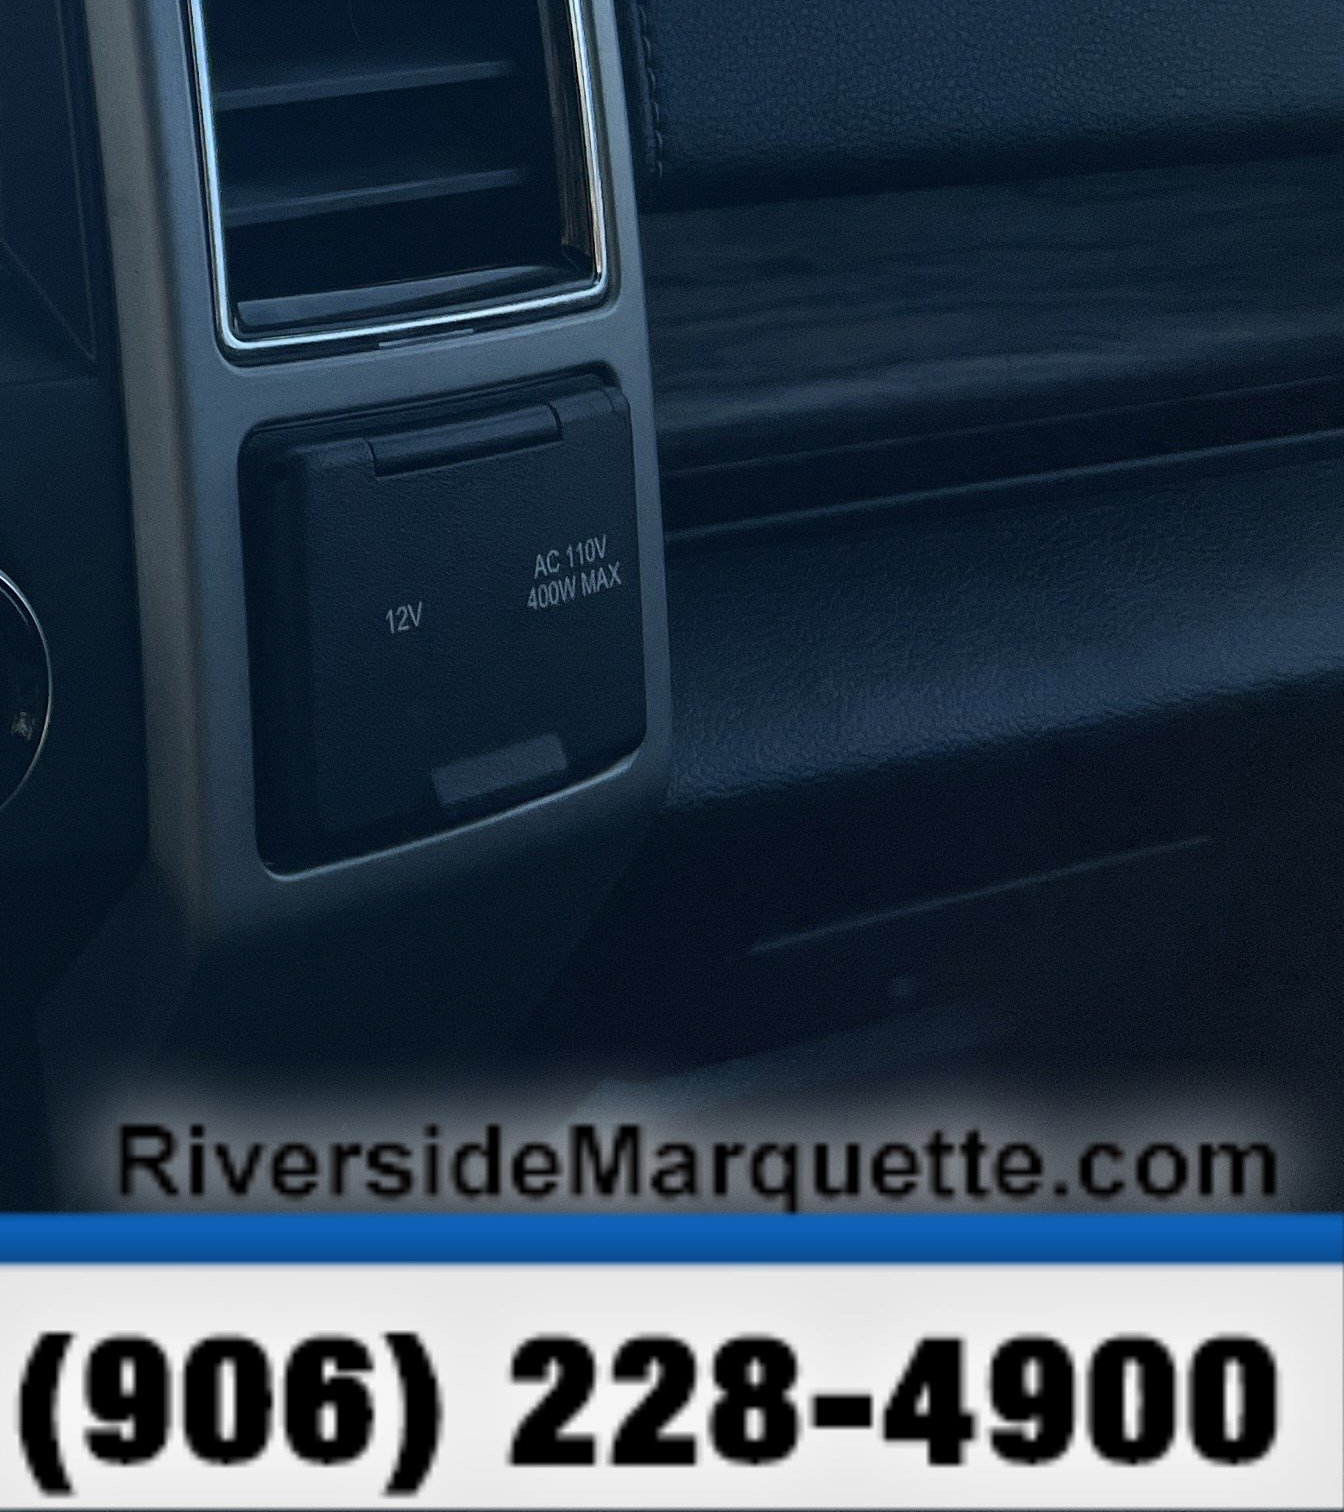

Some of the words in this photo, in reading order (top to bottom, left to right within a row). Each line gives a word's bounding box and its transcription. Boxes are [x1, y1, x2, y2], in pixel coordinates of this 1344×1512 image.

[533, 549, 561, 579] AC
[565, 534, 609, 570] 110V
[527, 574, 580, 611] 400W
[581, 561, 623, 599] MAX
[385, 601, 424, 634] 12V
